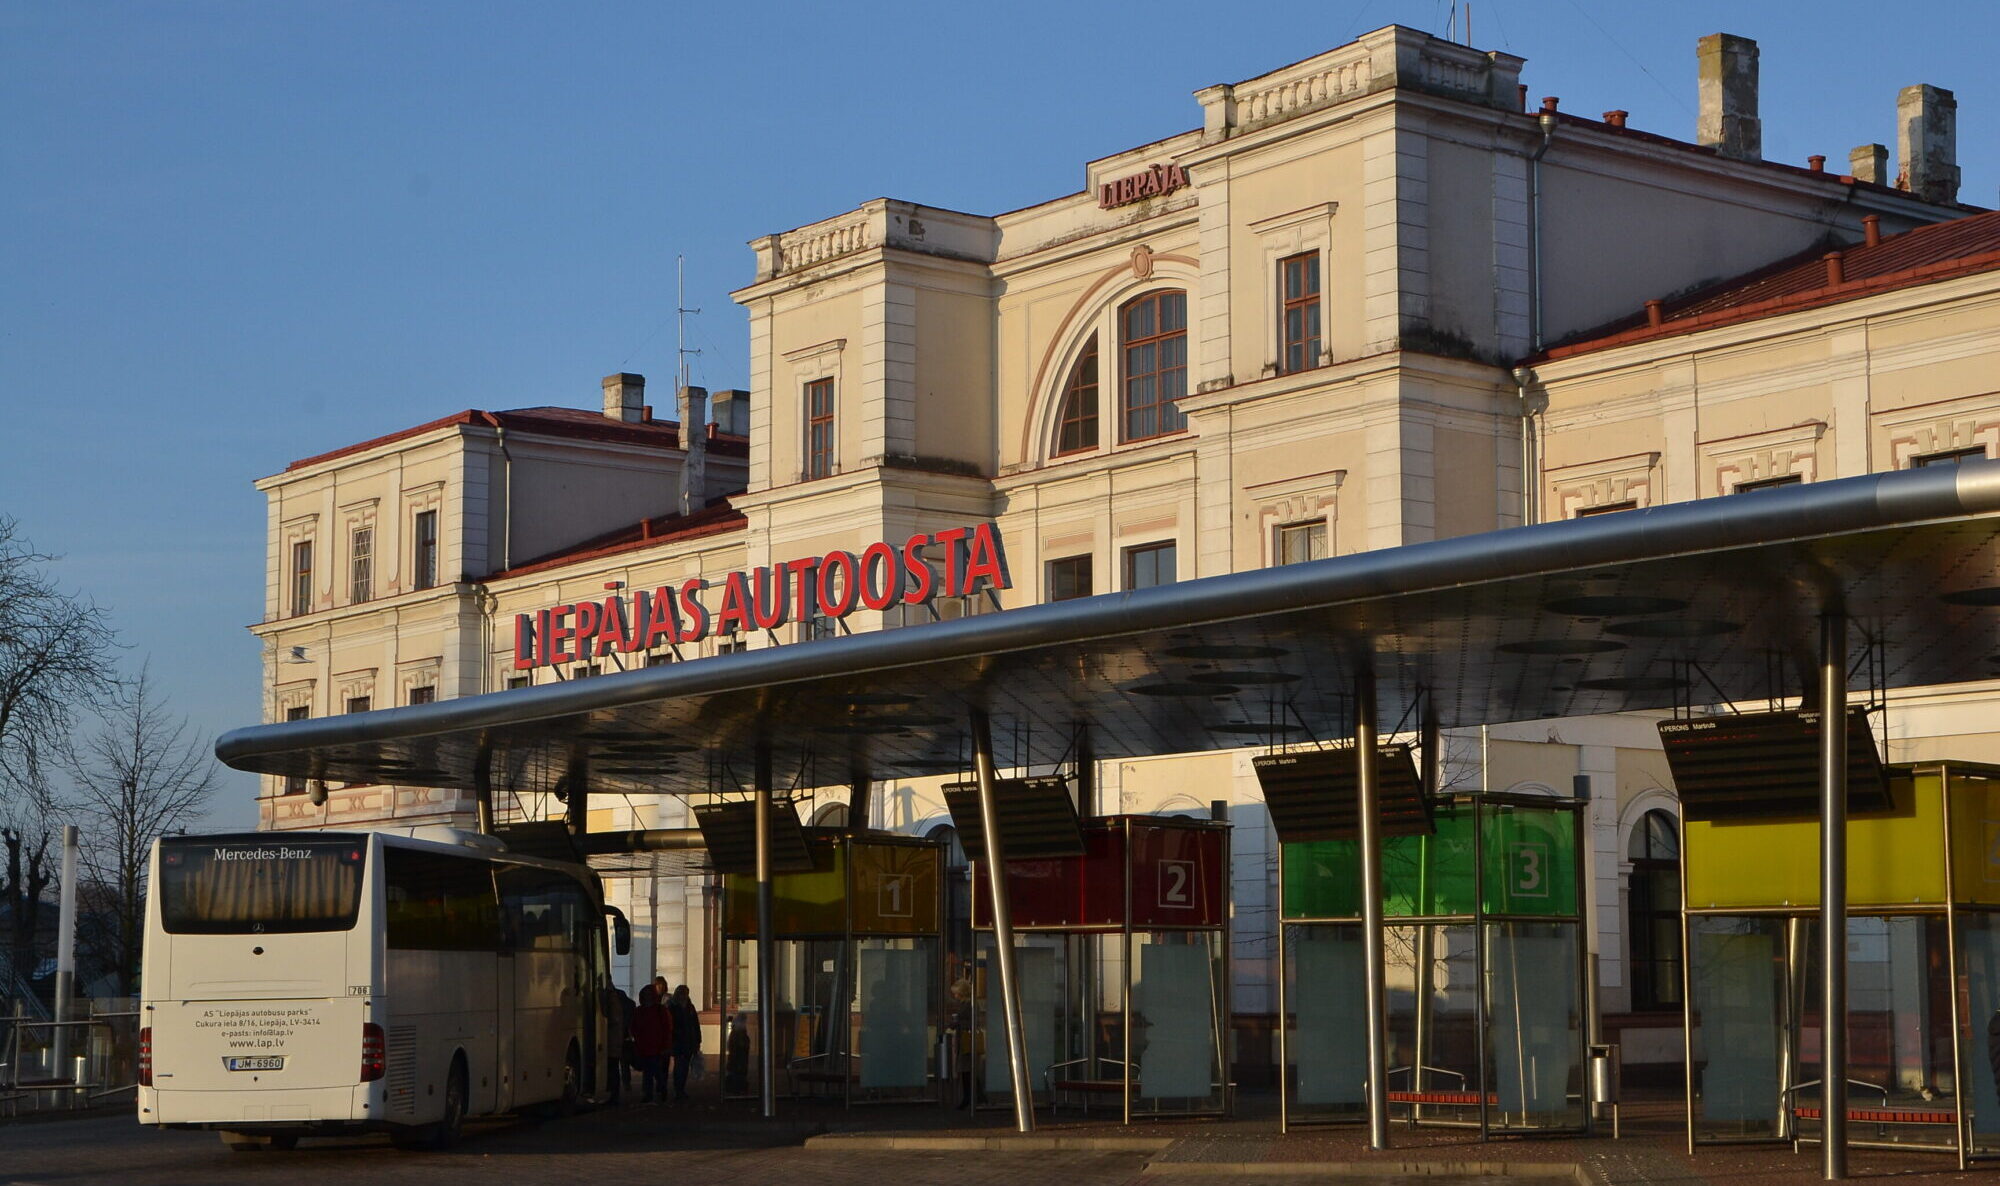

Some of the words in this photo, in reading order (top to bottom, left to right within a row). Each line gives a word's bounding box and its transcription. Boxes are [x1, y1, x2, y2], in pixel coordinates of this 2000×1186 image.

[1098, 162, 1187, 210] LIEPĀJA
[514, 580, 710, 670] LIEPĀJAS
[716, 522, 1013, 636] AUTOOSTA
[214, 847, 312, 860] Mercedes-Benz
[1519, 849, 1540, 890] 3
[1166, 865, 1187, 902] 2
[886, 879, 901, 912] 1
[351, 987, 368, 995] 706
[203, 1010, 214, 1018] AS
[290, 1018, 320, 1026] LV-3414
[253, 1029, 294, 1038] info@lap.lv
[229, 1038, 285, 1049] www.lap.lv
[237, 1058, 281, 1069] JM-6960
